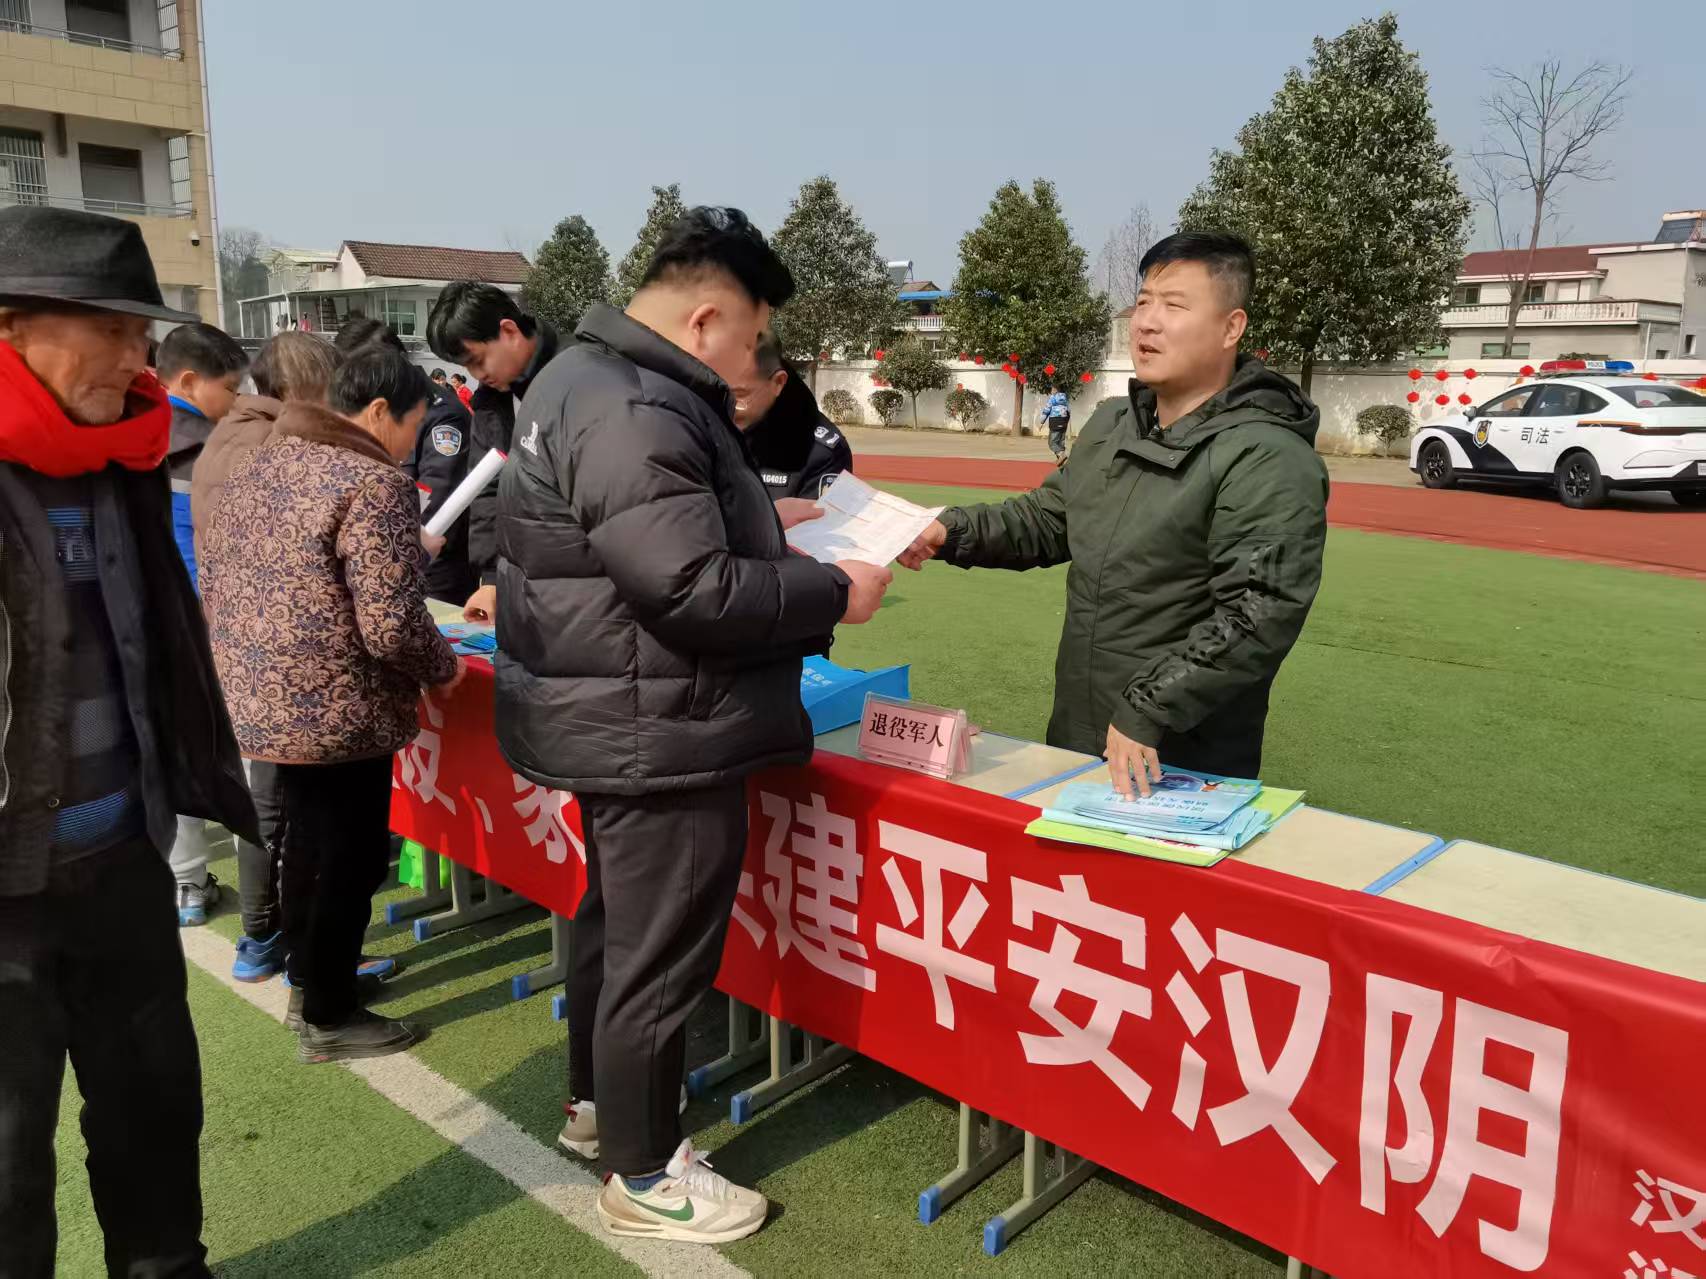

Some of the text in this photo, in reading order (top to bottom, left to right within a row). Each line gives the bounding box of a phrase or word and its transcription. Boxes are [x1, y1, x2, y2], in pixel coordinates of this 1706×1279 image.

[1521, 427, 1550, 444] 司法
[869, 712, 944, 747] 退役军人
[732, 790, 1570, 1272] 建平安汉阴
